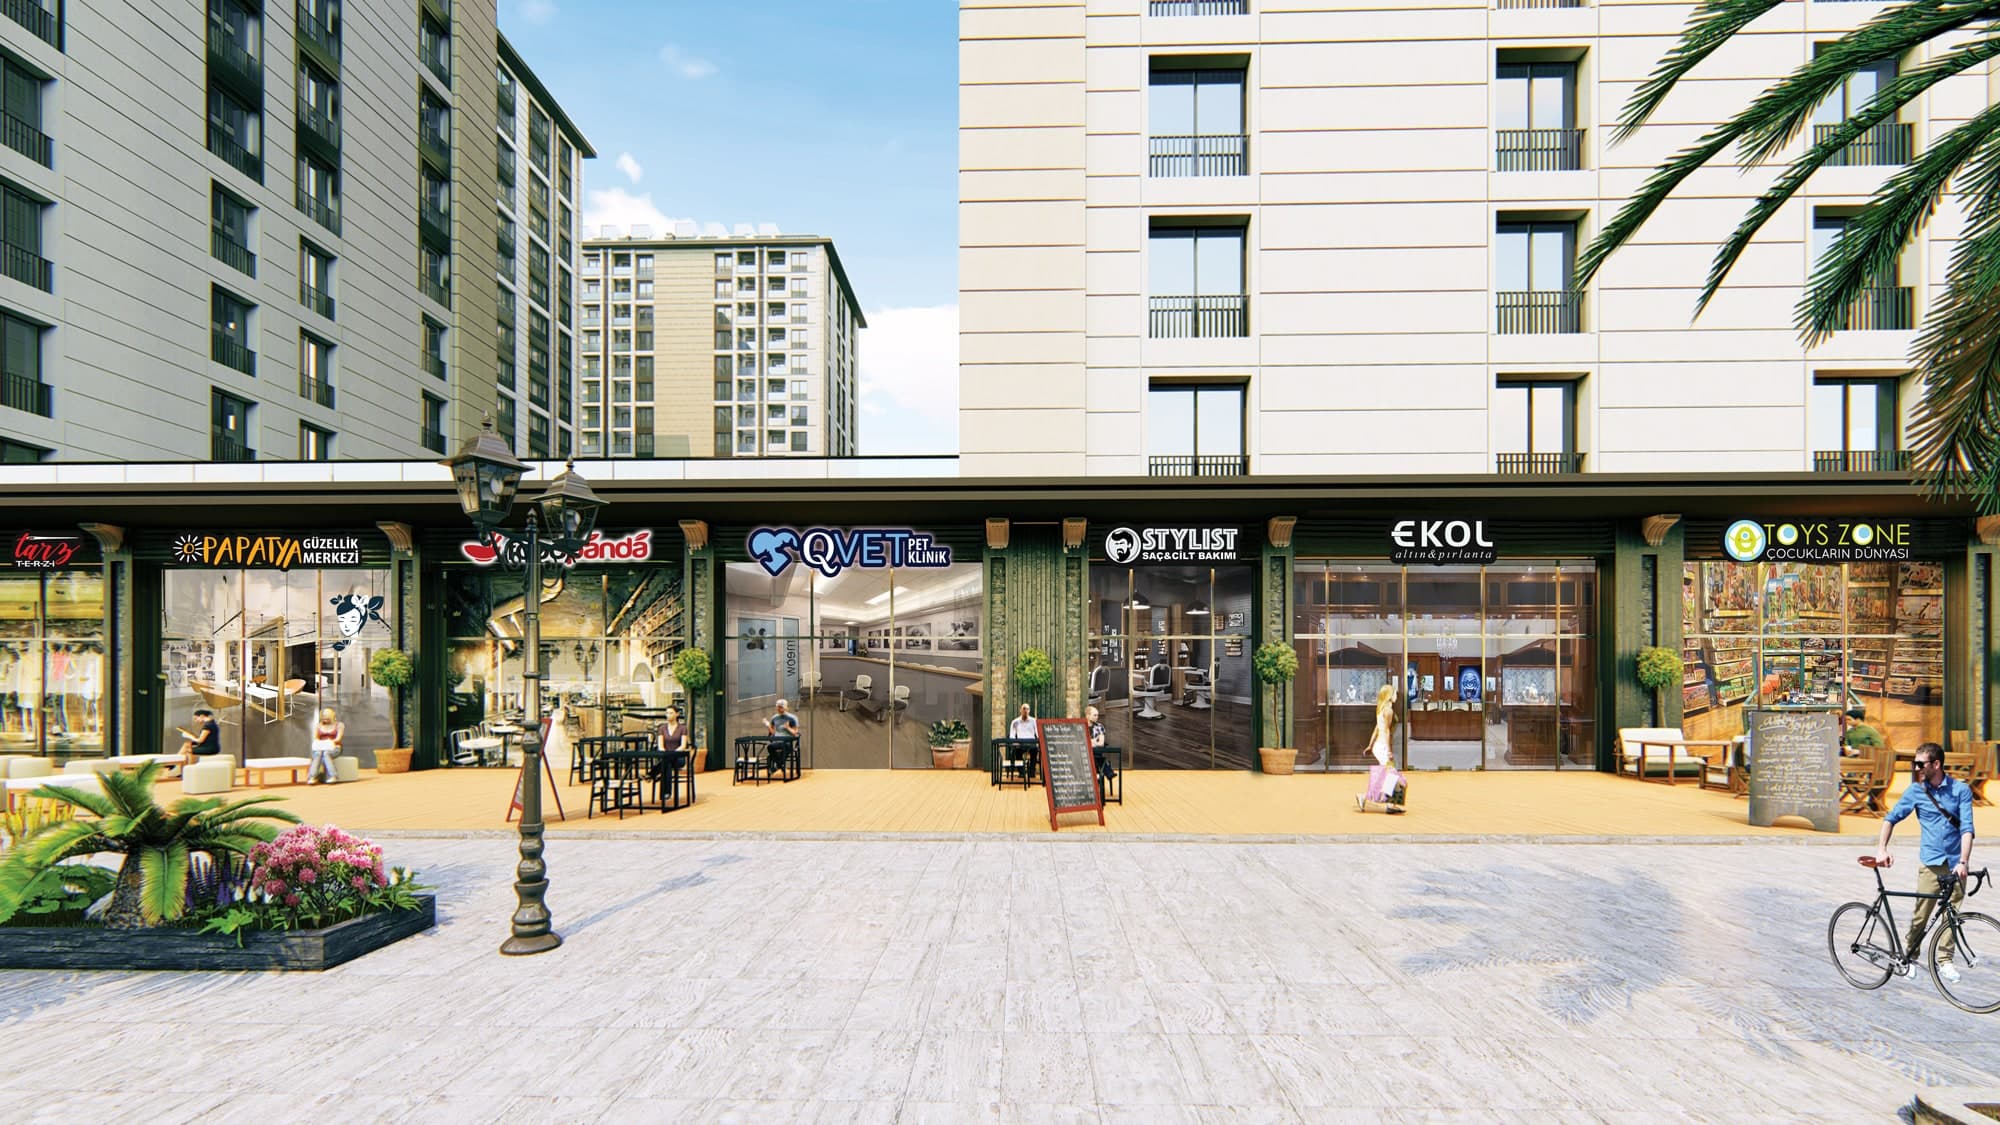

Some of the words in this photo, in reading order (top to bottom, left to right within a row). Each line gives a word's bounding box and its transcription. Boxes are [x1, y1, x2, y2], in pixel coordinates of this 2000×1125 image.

[303, 536, 359, 549] GÜZELLİK
[908, 538, 929, 551] PET
[1142, 528, 1238, 550] STYLIST
[1391, 520, 1494, 548] EKOL
[1764, 523, 1828, 546] TOYS
[1838, 523, 1910, 546] ZONE
[15, 532, 81, 566] tarz
[203, 536, 302, 568] PAPATYA
[303, 550, 359, 564] MERKEZİ
[802, 531, 910, 575] QVET
[1142, 551, 1194, 561] SAÇ&CİLT
[1199, 552, 1237, 560] BAKIMI
[1766, 548, 1850, 561] ÇOCUKLARIN
[1855, 546, 1909, 559] DÜNYASI
